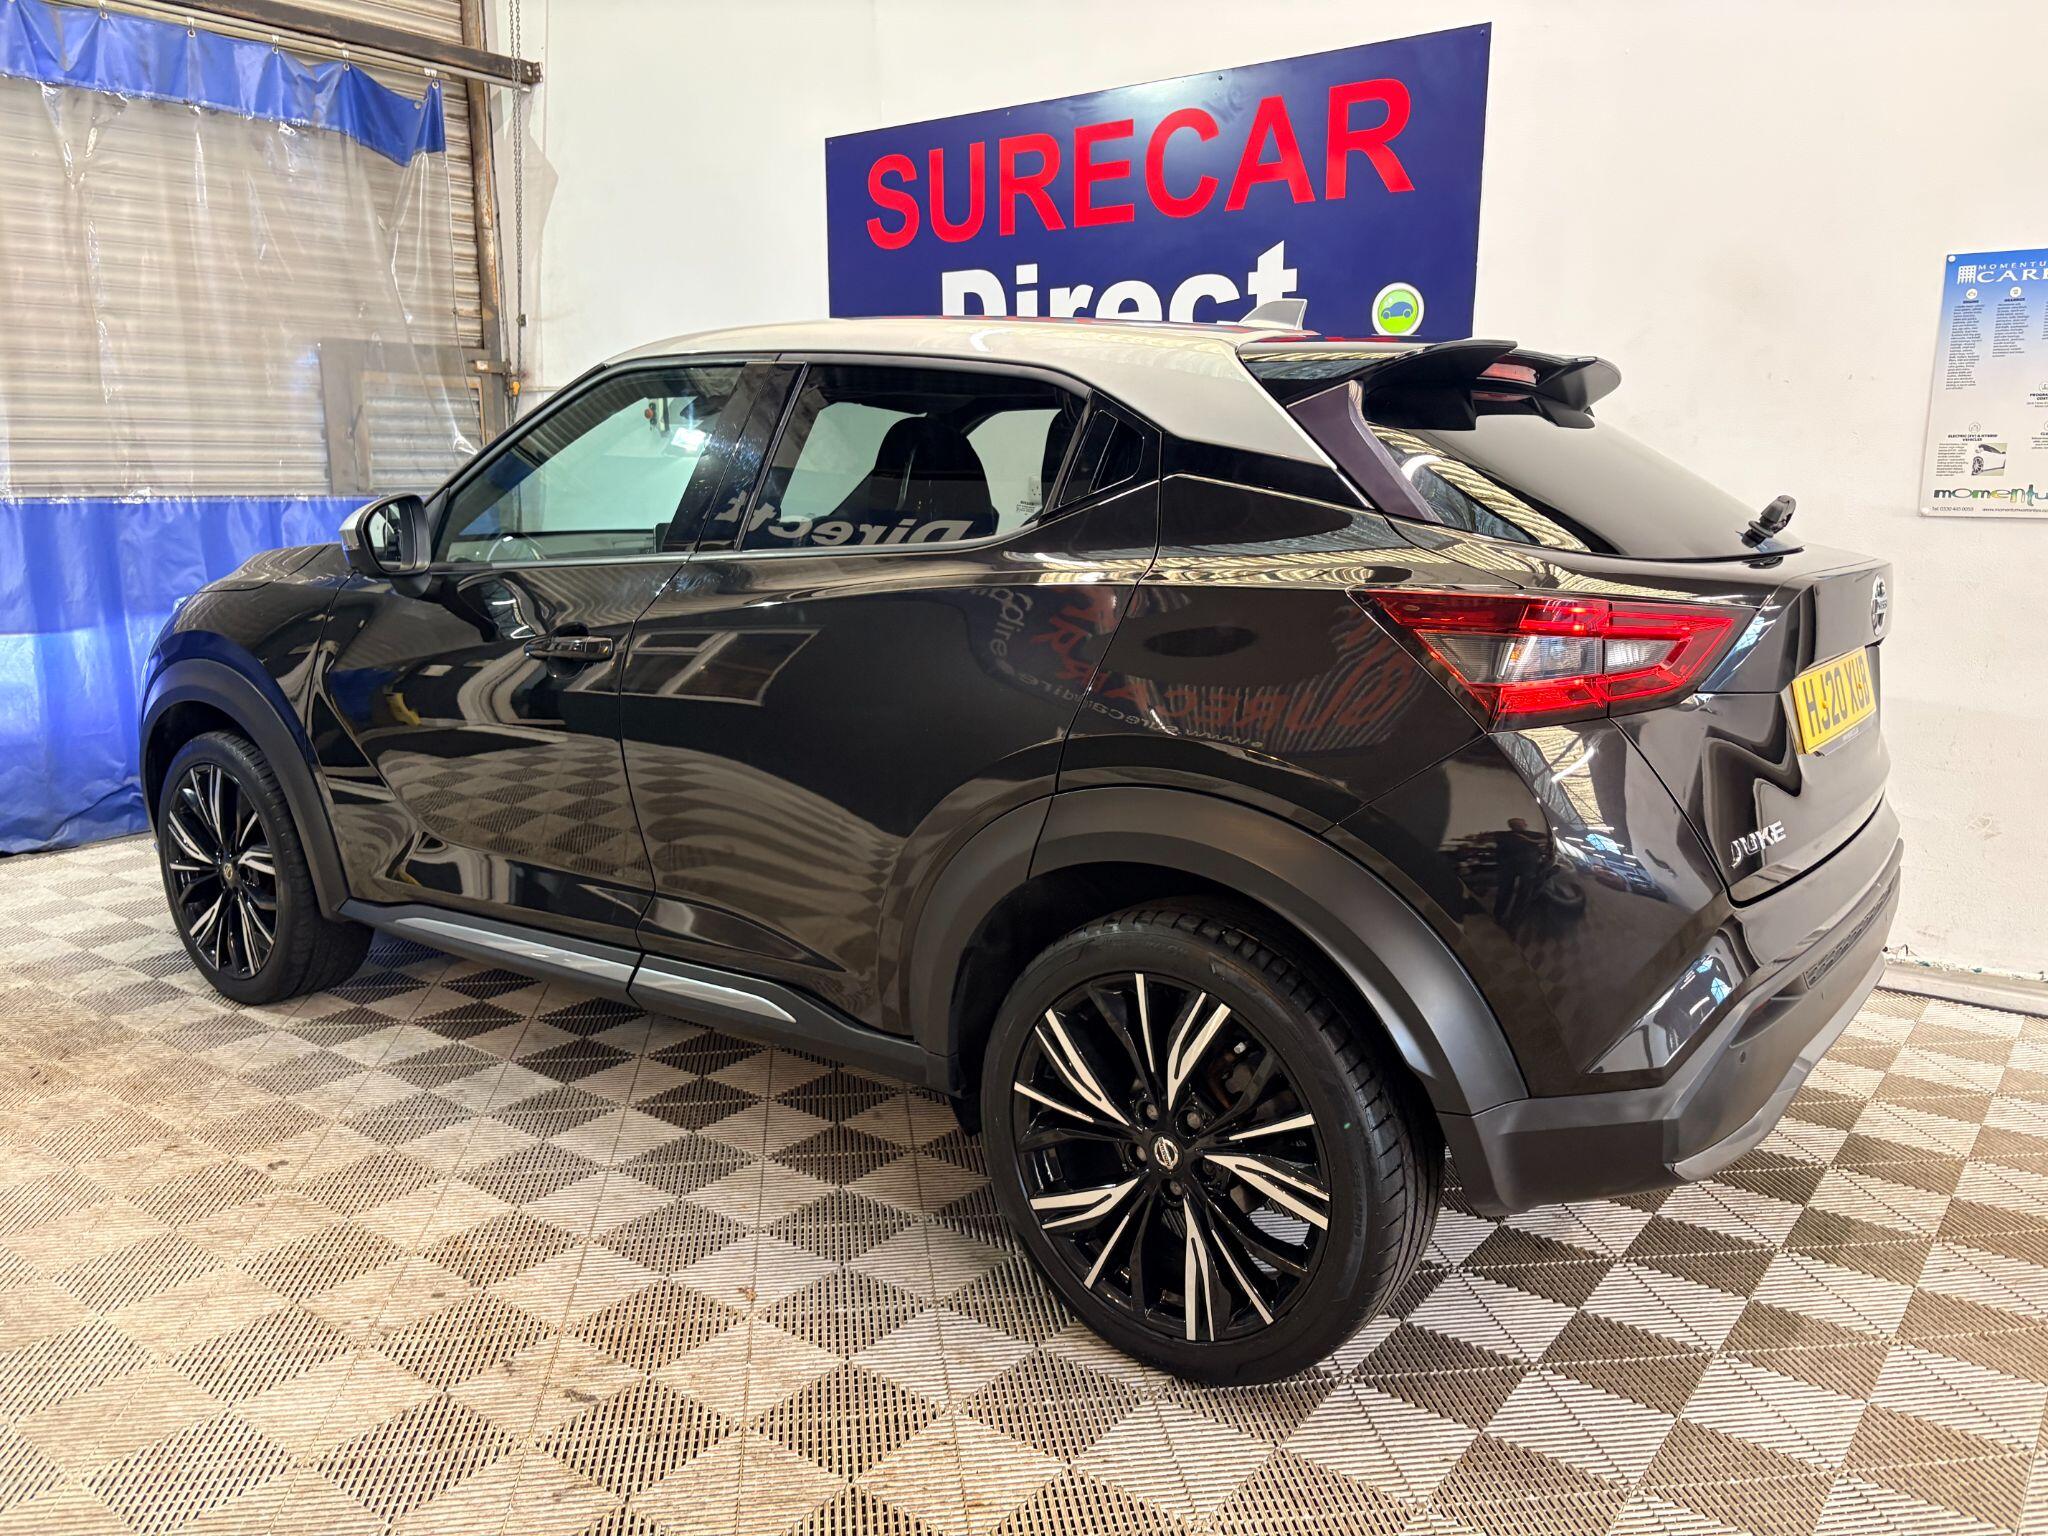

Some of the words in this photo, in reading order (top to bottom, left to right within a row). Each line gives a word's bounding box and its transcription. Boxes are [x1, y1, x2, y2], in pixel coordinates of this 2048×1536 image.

[867, 78, 1415, 249] SURECAR
[1803, 667, 1848, 737] HJ20
[1729, 820, 1786, 869] JUKE
